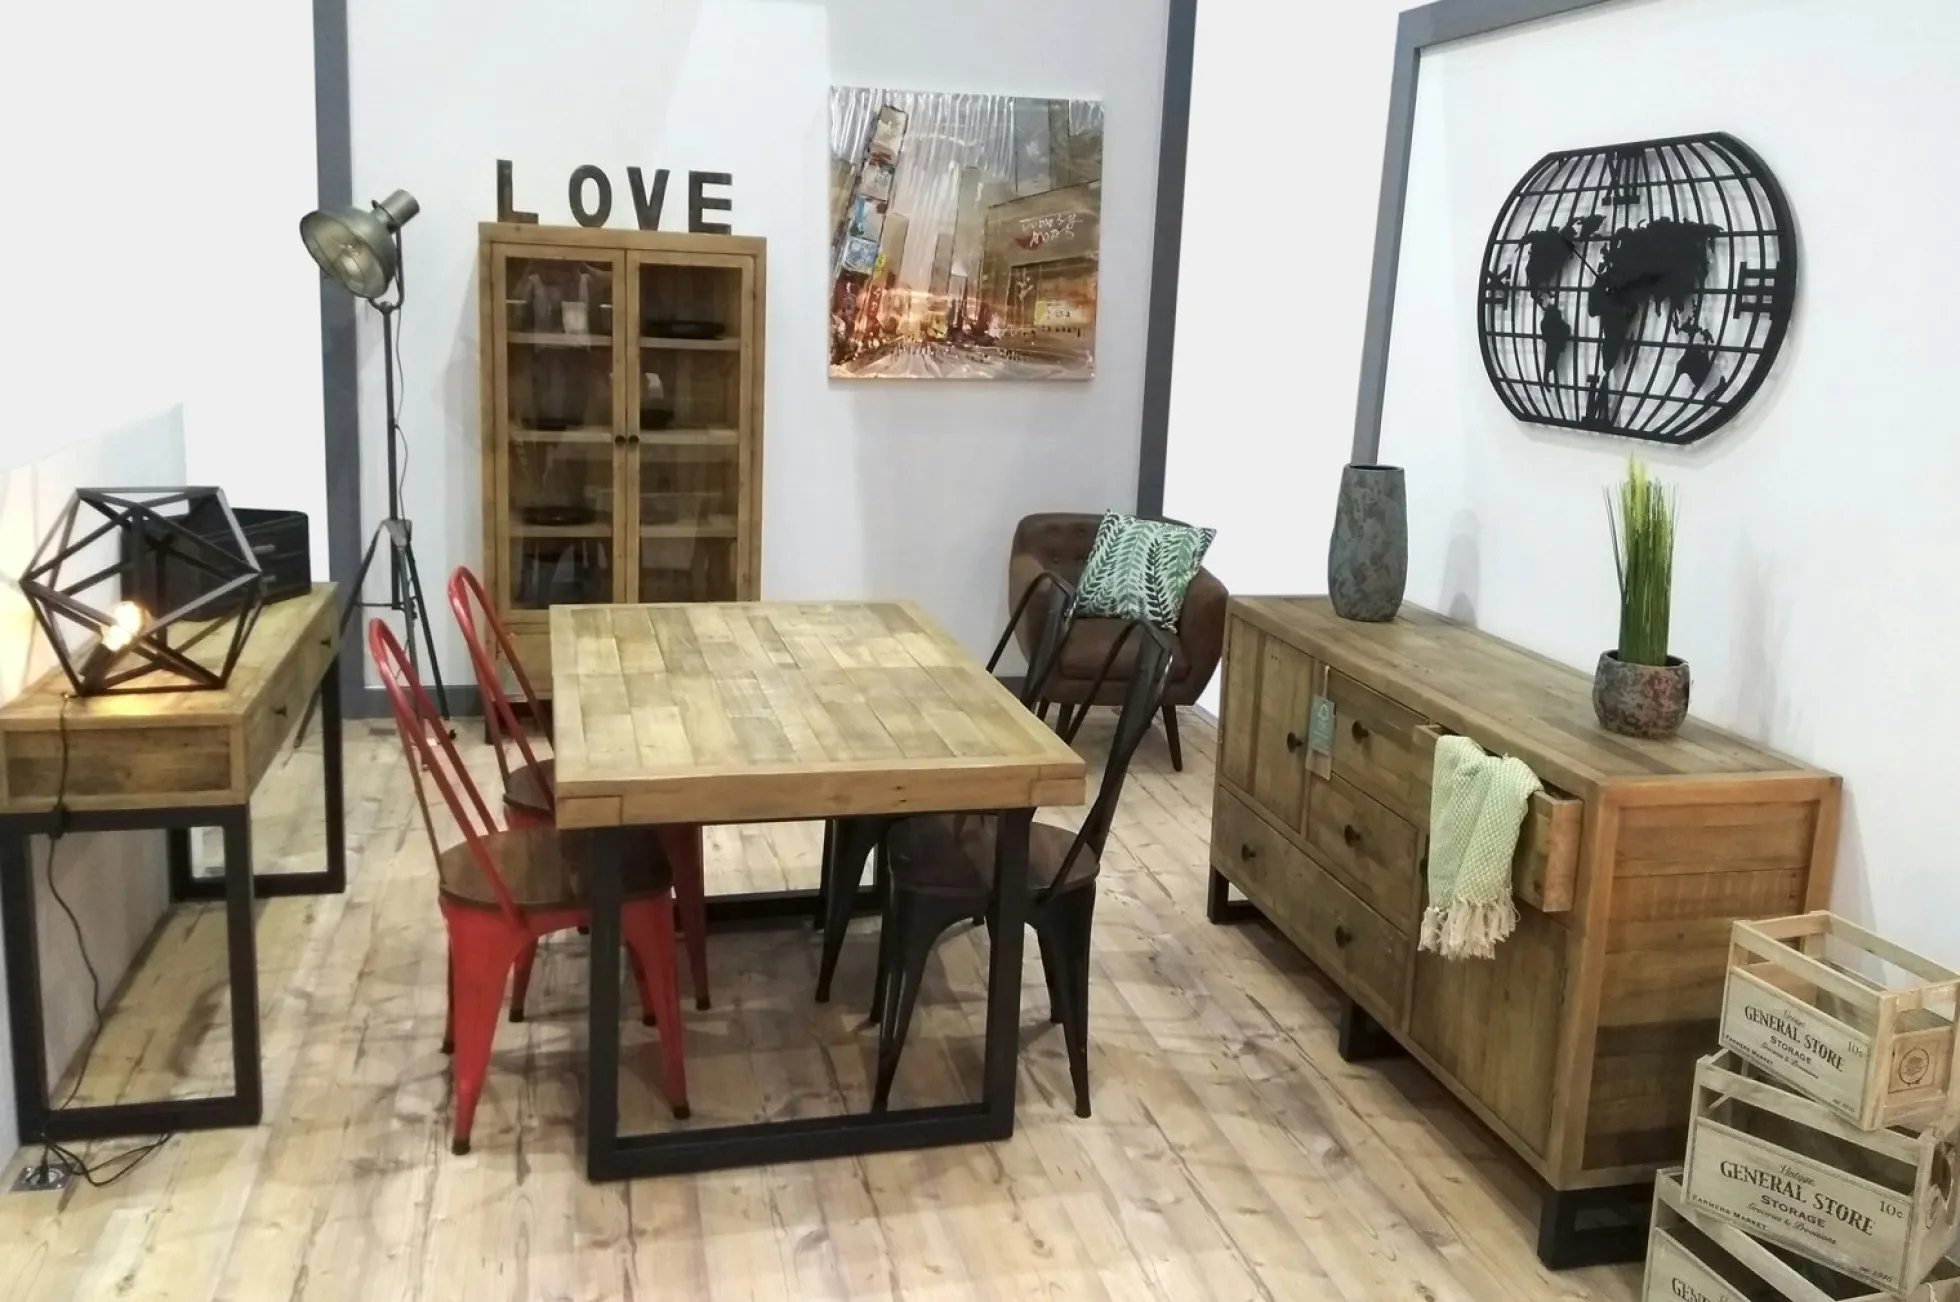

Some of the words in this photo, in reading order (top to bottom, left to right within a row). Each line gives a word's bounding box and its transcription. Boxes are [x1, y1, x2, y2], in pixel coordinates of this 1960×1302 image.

[496, 159, 733, 235] LOVE
[1744, 1005, 1801, 1044] GENERAL
[1803, 1034, 1845, 1073] STORE
[1770, 1035, 1812, 1065] STORAGE
[1693, 1194, 1730, 1215] FARMERS
[1733, 1211, 1767, 1231] MARKET
[1720, 1160, 1806, 1204] GENERAL
[1813, 1193, 1876, 1236] STORE
[1761, 1195, 1826, 1228] STORAGE
